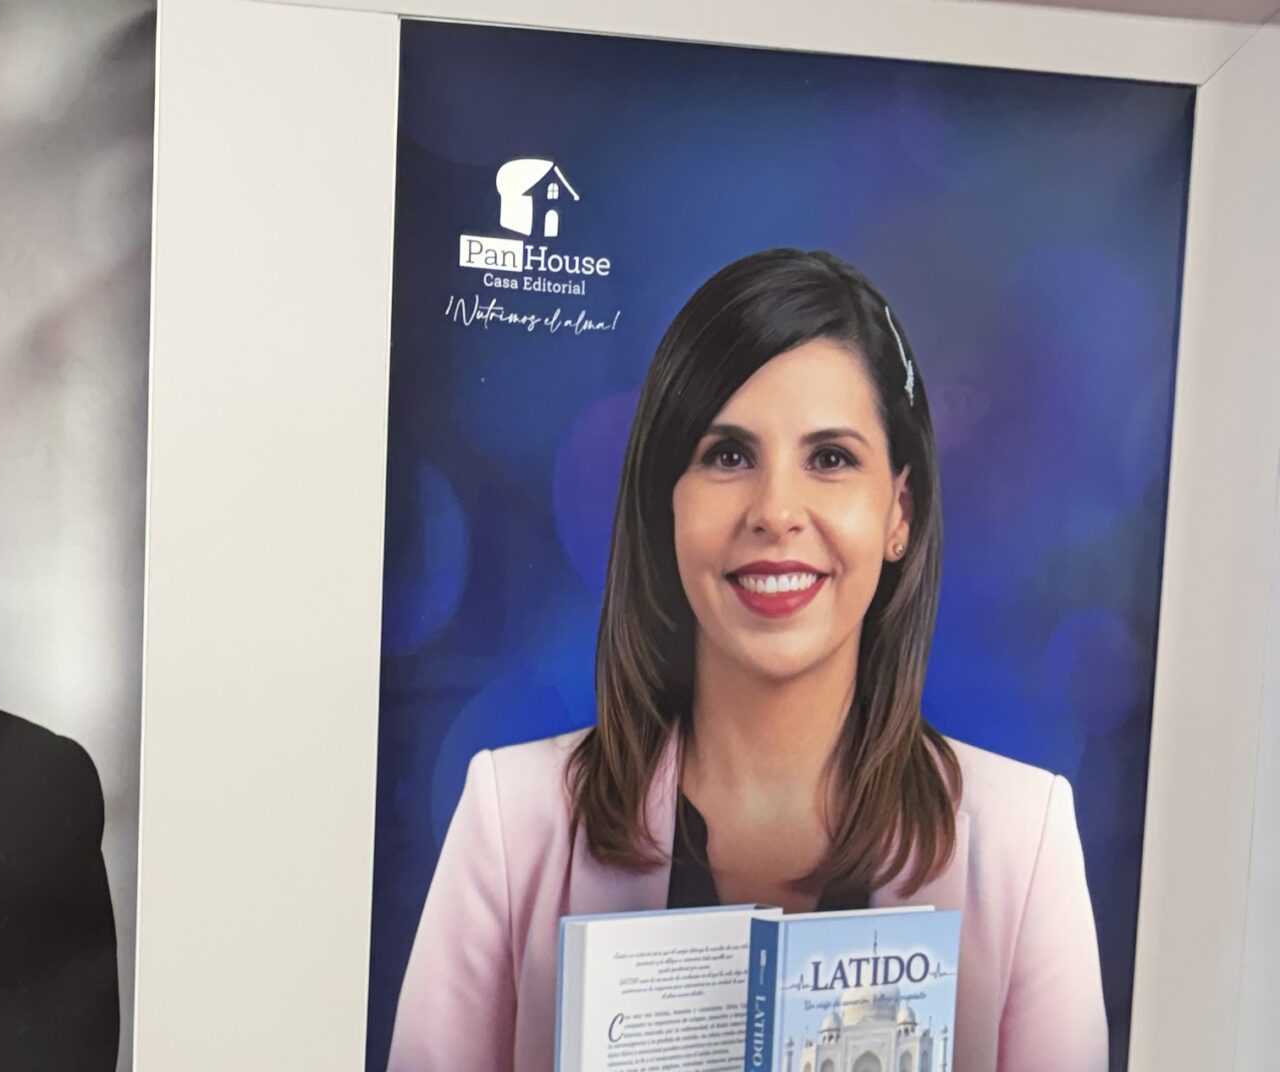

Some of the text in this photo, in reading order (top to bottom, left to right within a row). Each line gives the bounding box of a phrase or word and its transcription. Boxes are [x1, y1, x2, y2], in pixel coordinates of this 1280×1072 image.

[524, 245, 611, 276] House
[483, 273, 586, 296] Casa Editorial
[543, 308, 562, 333] el
[564, 310, 621, 336] alma!
[811, 952, 930, 992] LATIDO
[753, 995, 766, 1066] LATIDO
